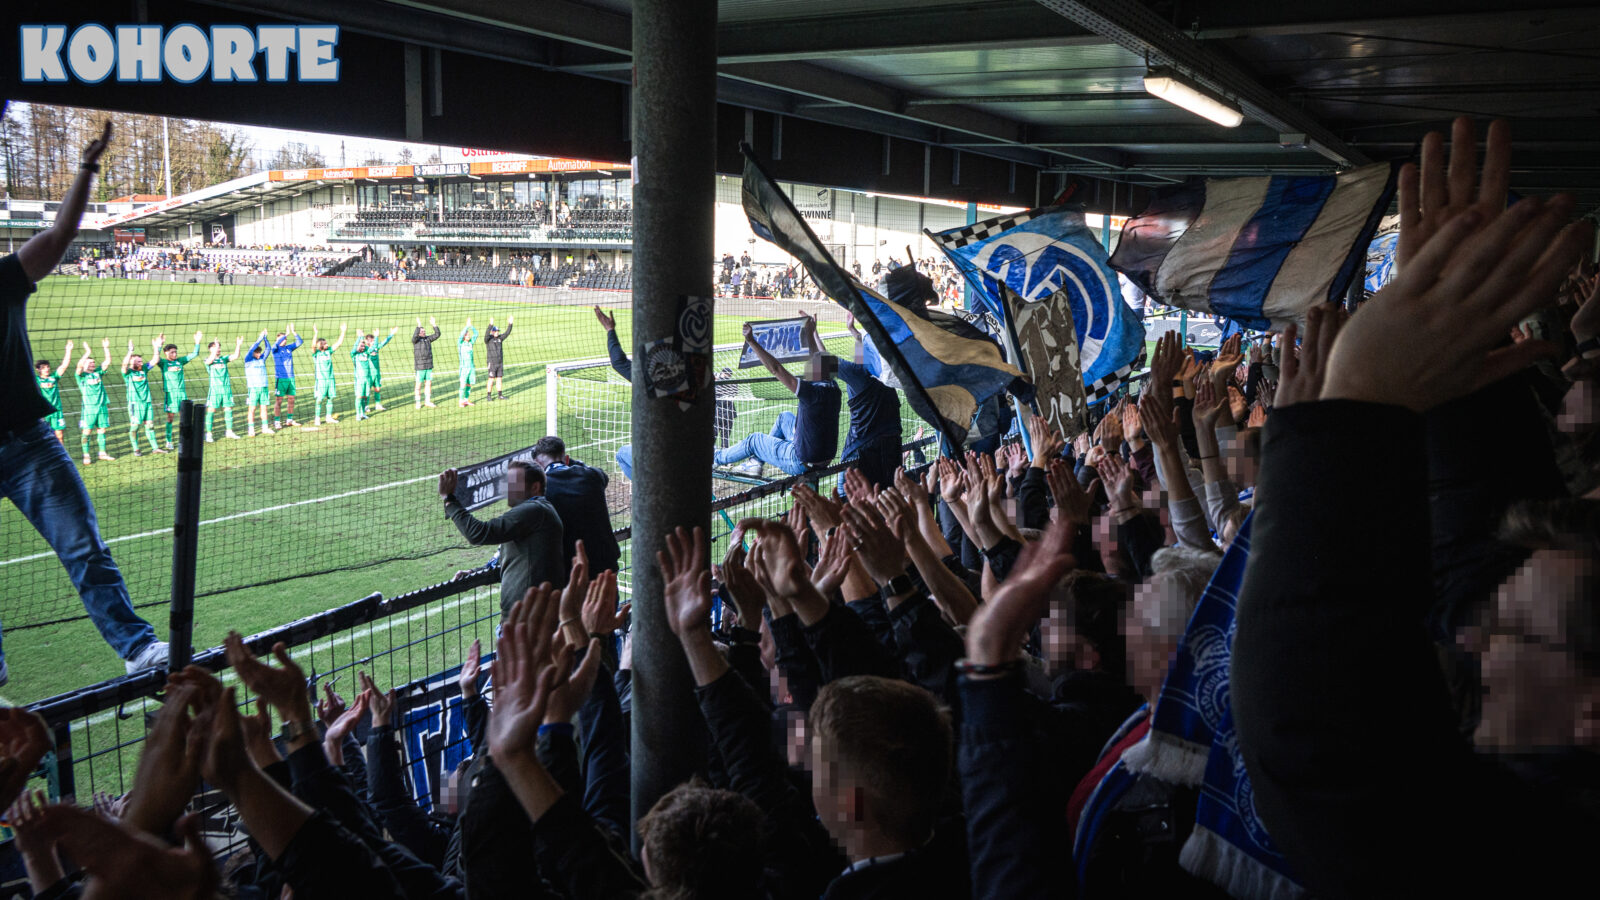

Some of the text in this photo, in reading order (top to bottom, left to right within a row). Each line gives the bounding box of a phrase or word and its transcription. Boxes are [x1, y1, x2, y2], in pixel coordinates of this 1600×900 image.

[491, 162, 527, 172] BECKHOFF
[547, 160, 592, 171] Automation
[798, 210, 832, 220] EWINNE
